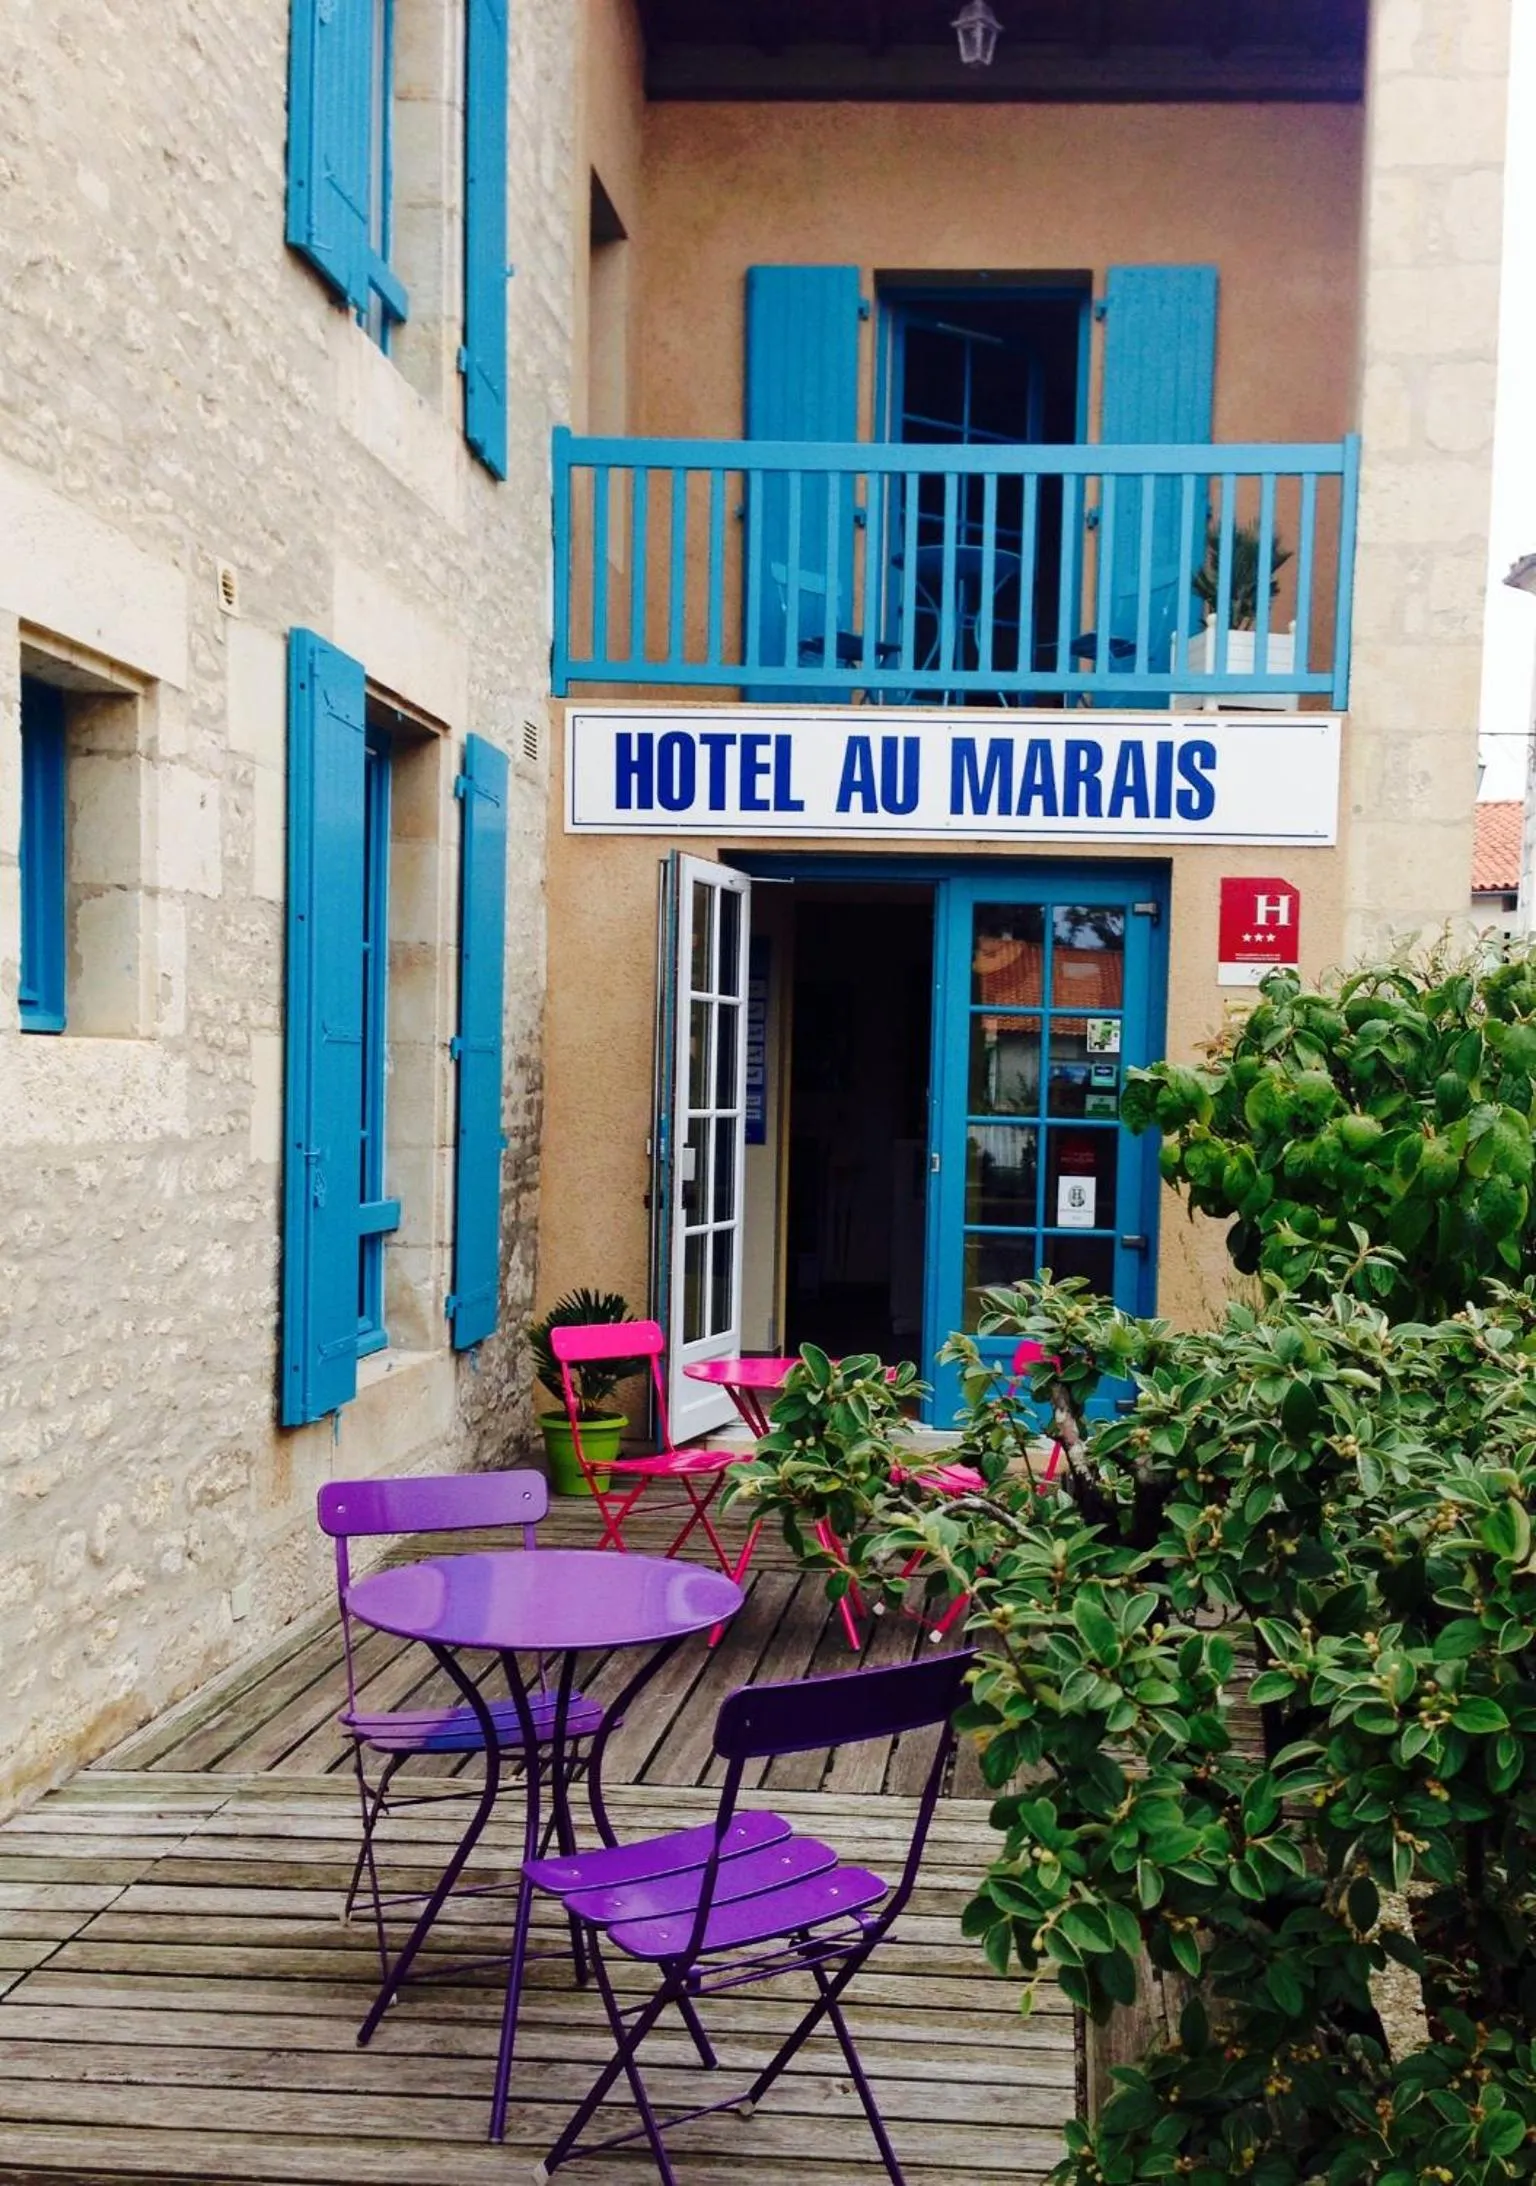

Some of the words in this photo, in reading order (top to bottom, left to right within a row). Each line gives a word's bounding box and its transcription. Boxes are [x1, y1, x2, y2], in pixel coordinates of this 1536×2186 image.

[615, 731, 805, 812] HOTEL
[836, 736, 921, 816] AU
[949, 738, 1217, 821] MARAIS
[1253, 894, 1292, 926] H
